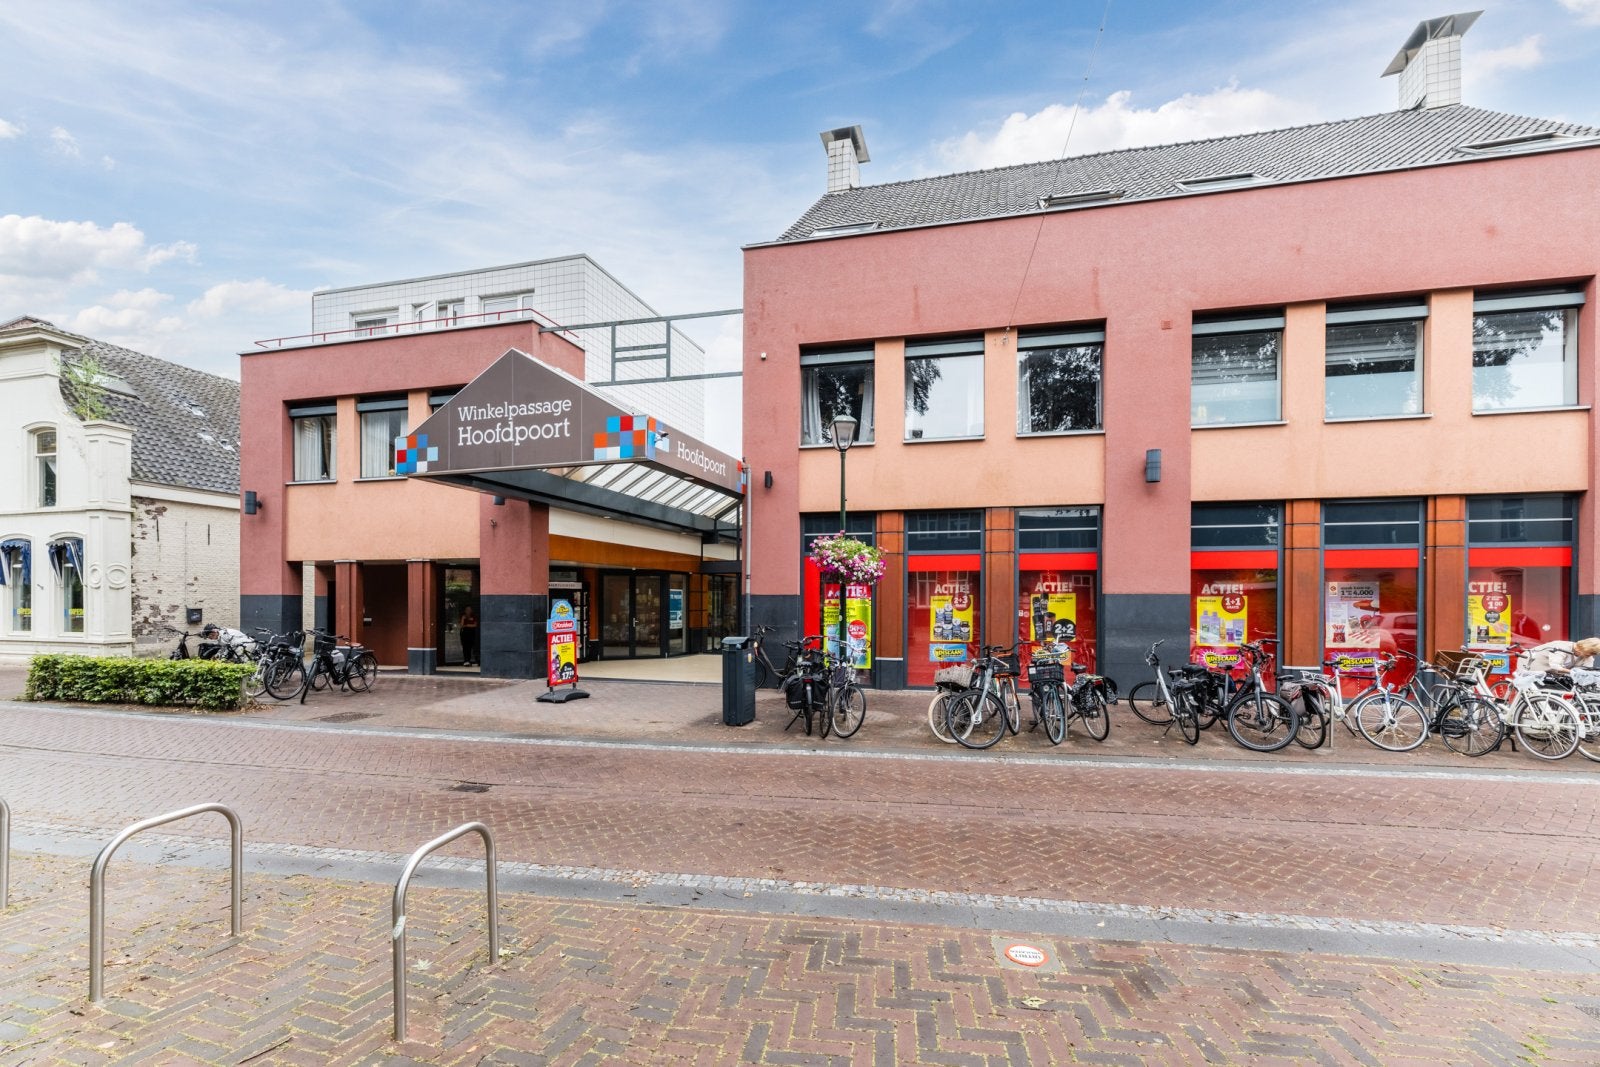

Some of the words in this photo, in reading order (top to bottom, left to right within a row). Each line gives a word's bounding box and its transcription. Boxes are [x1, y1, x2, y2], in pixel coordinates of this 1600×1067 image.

[458, 398, 572, 422] Winkelpassage
[458, 418, 570, 446] Hoofdpoort
[677, 441, 727, 477] Hoofdpoort
[934, 584, 970, 594] ACTIE!
[1035, 581, 1073, 592] ACTIE!
[1201, 583, 1244, 595] ACTIE!
[1468, 581, 1507, 593] CTIE!
[1225, 597, 1241, 606] 1+1
[1054, 623, 1074, 634] 2+2
[551, 633, 573, 644] ACTIE!
